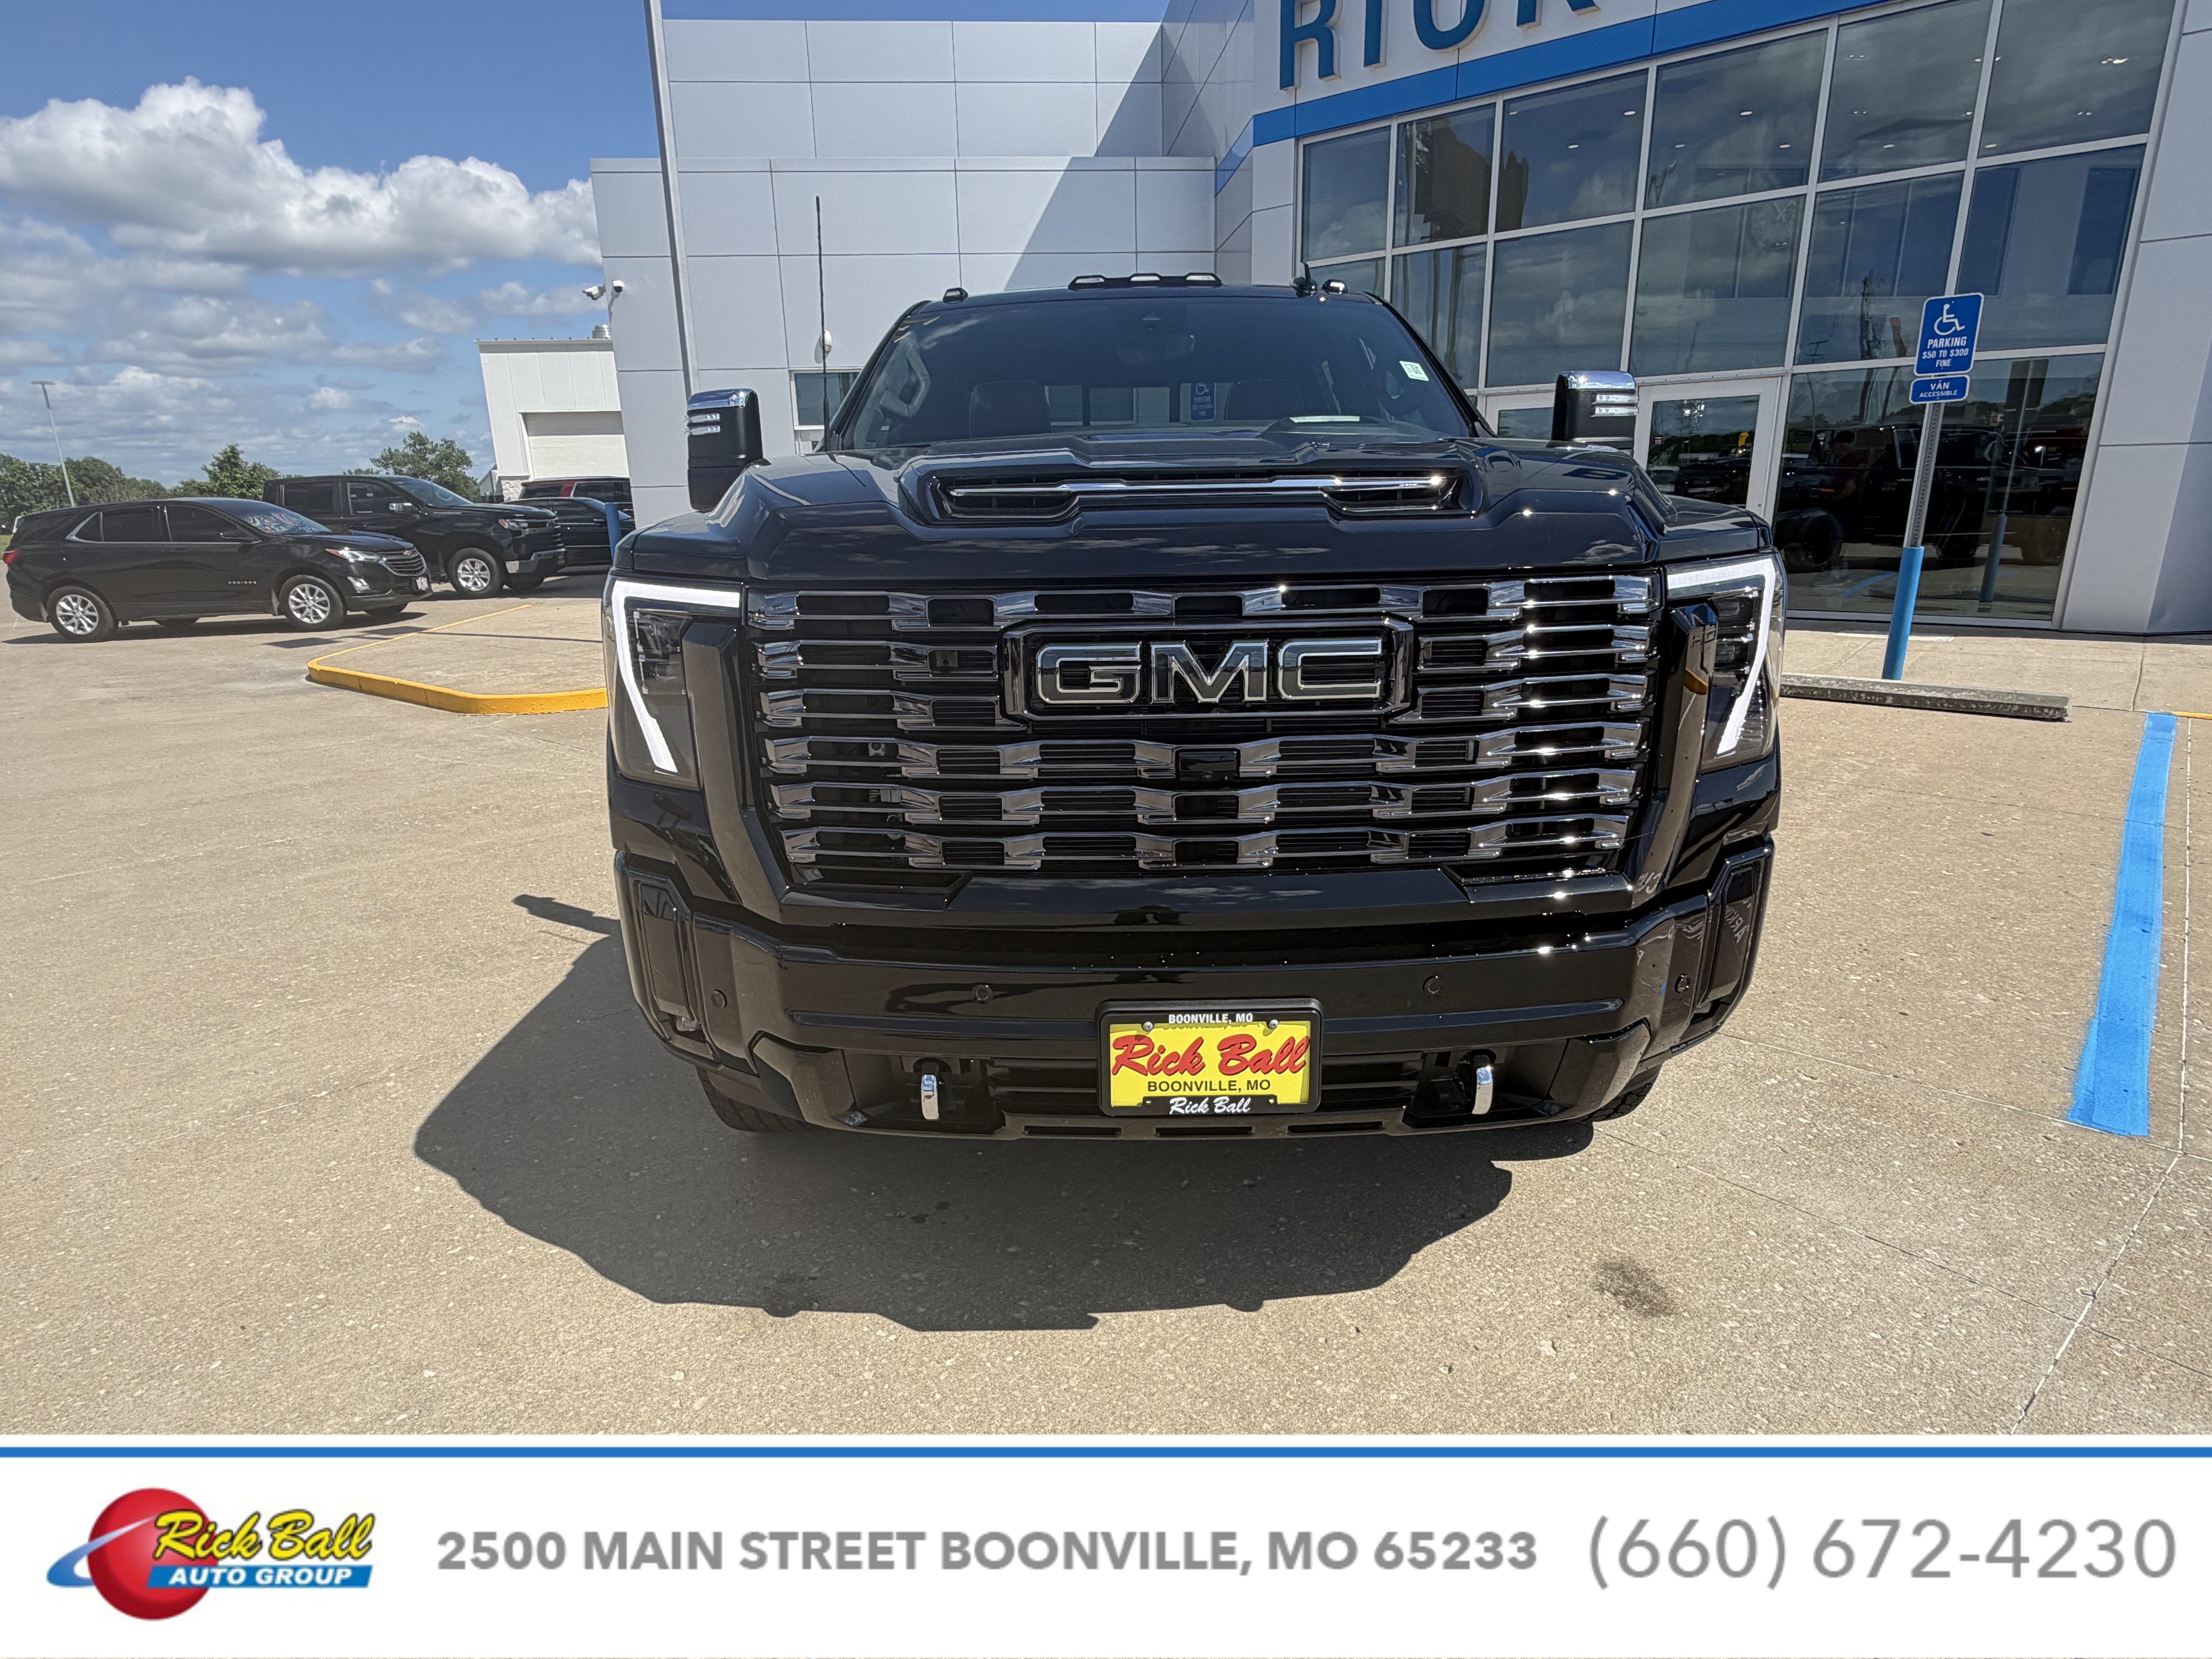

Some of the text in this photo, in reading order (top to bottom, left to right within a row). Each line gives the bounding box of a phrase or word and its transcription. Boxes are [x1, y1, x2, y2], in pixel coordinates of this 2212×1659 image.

[1927, 336, 1967, 349] PARKING
[1939, 349, 1948, 358] TO
[1936, 359, 1952, 368] FINE
[1930, 382, 1949, 390] VAN
[1919, 390, 1958, 398] ACCESSIBLE
[1036, 638, 1382, 704] GMC
[1168, 1013, 1253, 1024] BOONVILLE, MO
[1111, 1034, 1310, 1076] Rick Ball
[1147, 1079, 1271, 1092] BOONVILLE, MO
[1169, 1096, 1252, 1115] Rick Ball
